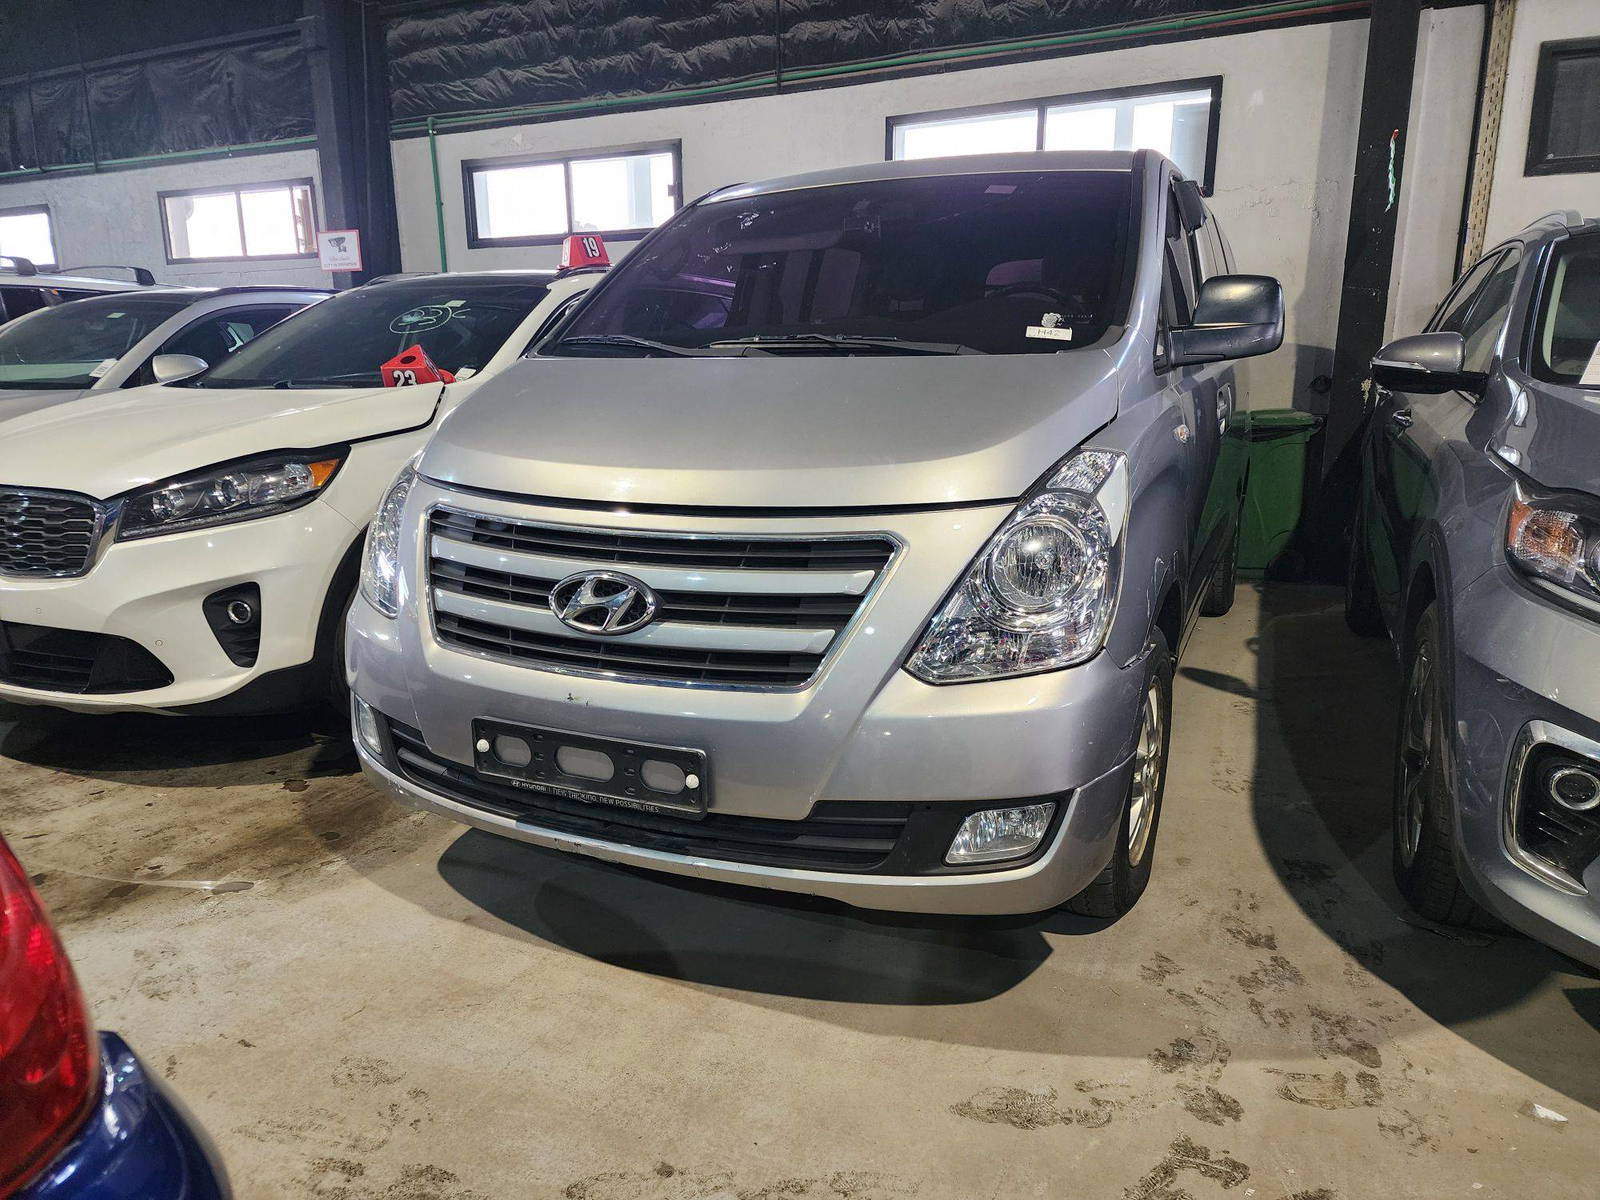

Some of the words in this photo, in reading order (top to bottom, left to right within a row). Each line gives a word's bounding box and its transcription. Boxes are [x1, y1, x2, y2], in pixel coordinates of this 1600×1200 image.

[583, 237, 600, 258] 19
[393, 369, 417, 387] 23
[521, 782, 547, 792] HYUNDAI
